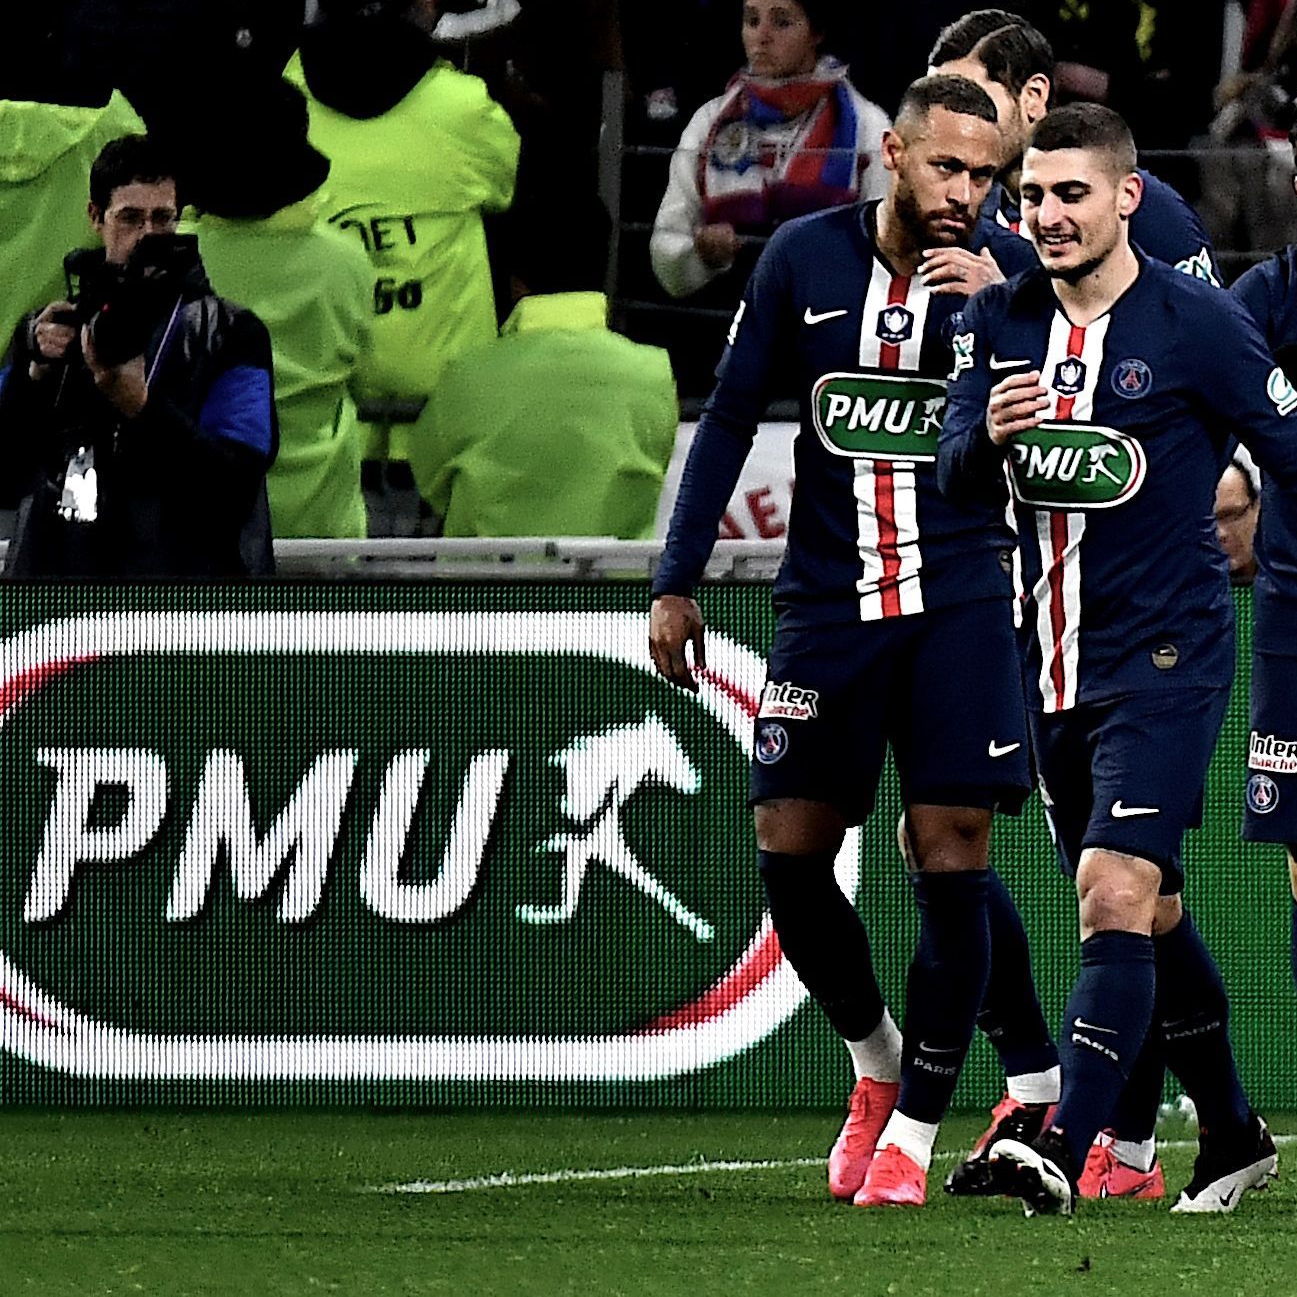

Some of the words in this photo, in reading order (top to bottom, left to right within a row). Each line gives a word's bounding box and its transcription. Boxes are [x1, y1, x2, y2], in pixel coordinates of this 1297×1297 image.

[825, 393, 916, 434] PMU
[23, 746, 512, 927] PMU
[1071, 1032, 1119, 1062] PARIS
[913, 1056, 958, 1076] PARIS
